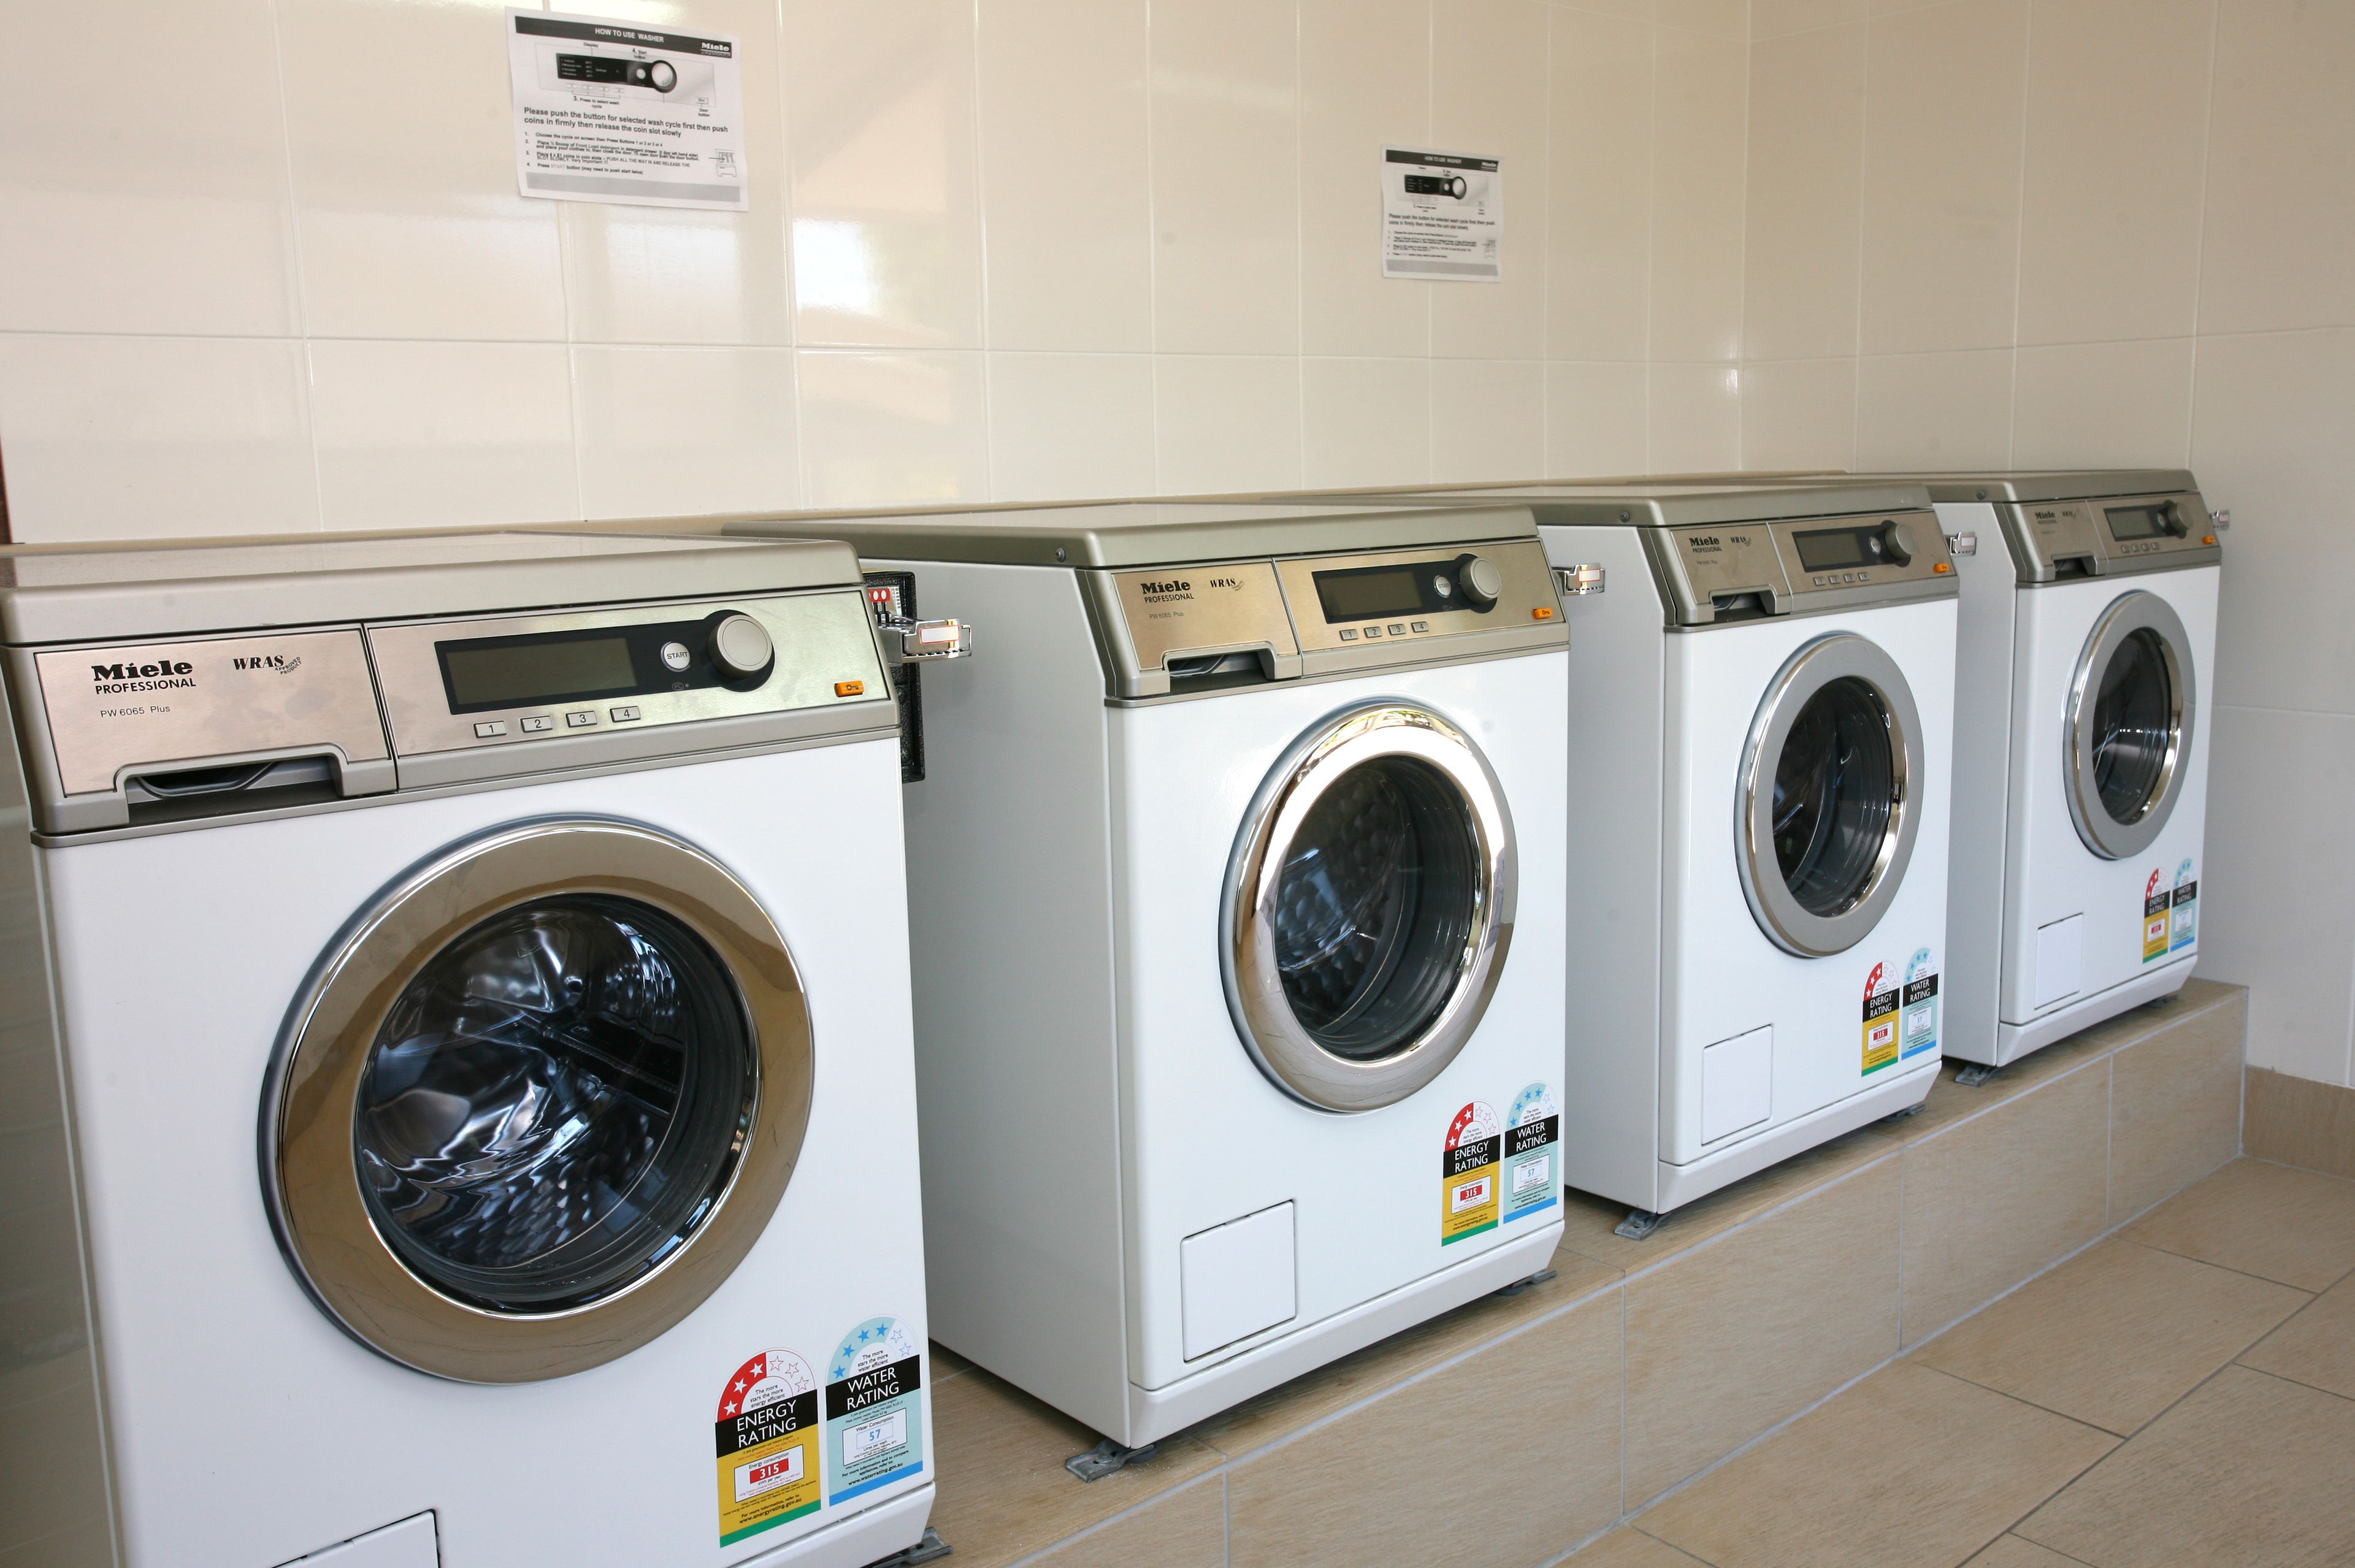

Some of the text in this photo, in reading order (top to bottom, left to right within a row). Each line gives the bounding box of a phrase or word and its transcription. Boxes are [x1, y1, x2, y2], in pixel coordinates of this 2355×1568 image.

[638, 34, 664, 43] WASHER
[702, 43, 730, 52] Miele
[524, 107, 548, 115] Please
[556, 119, 575, 128] firmly
[595, 123, 620, 131] release
[662, 129, 681, 138] slowly
[2035, 511, 2056, 519] Miele
[1689, 537, 1720, 546] Miele
[1141, 580, 1191, 595] Miele
[1210, 578, 1236, 588] WRAS
[1144, 594, 1194, 603] PROFESSIONAL
[667, 651, 688, 660] START
[91, 655, 285, 682] Miele WRAS
[274, 656, 302, 671] APPROVED
[280, 660, 303, 676] PRODUCT
[95, 677, 196, 695] PROFESSIONAL
[101, 705, 170, 719] PW 6065 Plus
[488, 709, 630, 733] 1 2 3 4
[2149, 895, 2165, 906] ENERGY
[2177, 892, 2192, 904] RATING
[2149, 903, 2165, 915] RATING
[1911, 979, 1929, 992] WATER
[1871, 993, 1893, 1008] ENERGY
[1910, 989, 1931, 1003] RATING
[1871, 1003, 1892, 1018] RATING
[1517, 1122, 1545, 1138] WATER
[1516, 1133, 1547, 1152] RATING
[1455, 1141, 1489, 1160] ENERGY
[1455, 1154, 1488, 1172] RATING
[1528, 1168, 1534, 1177] 57
[1465, 1187, 1477, 1198] 315
[872, 1359, 888, 1367] efficient
[848, 1367, 896, 1393] WATER
[768, 1393, 785, 1402] efficient
[847, 1382, 899, 1410] RATING
[737, 1399, 796, 1431] ENERGY
[869, 1415, 894, 1428] Consumption
[738, 1417, 796, 1448] RATING
[870, 1429, 881, 1441] 57
[749, 1452, 789, 1469] Energy consumption
[860, 1461, 881, 1470] information
[759, 1463, 779, 1479] 315
[848, 1463, 903, 1485] www.waterrating.gov.au
[740, 1497, 802, 1524] www.energyrating.gov.au
[760, 1500, 784, 1510] information,
